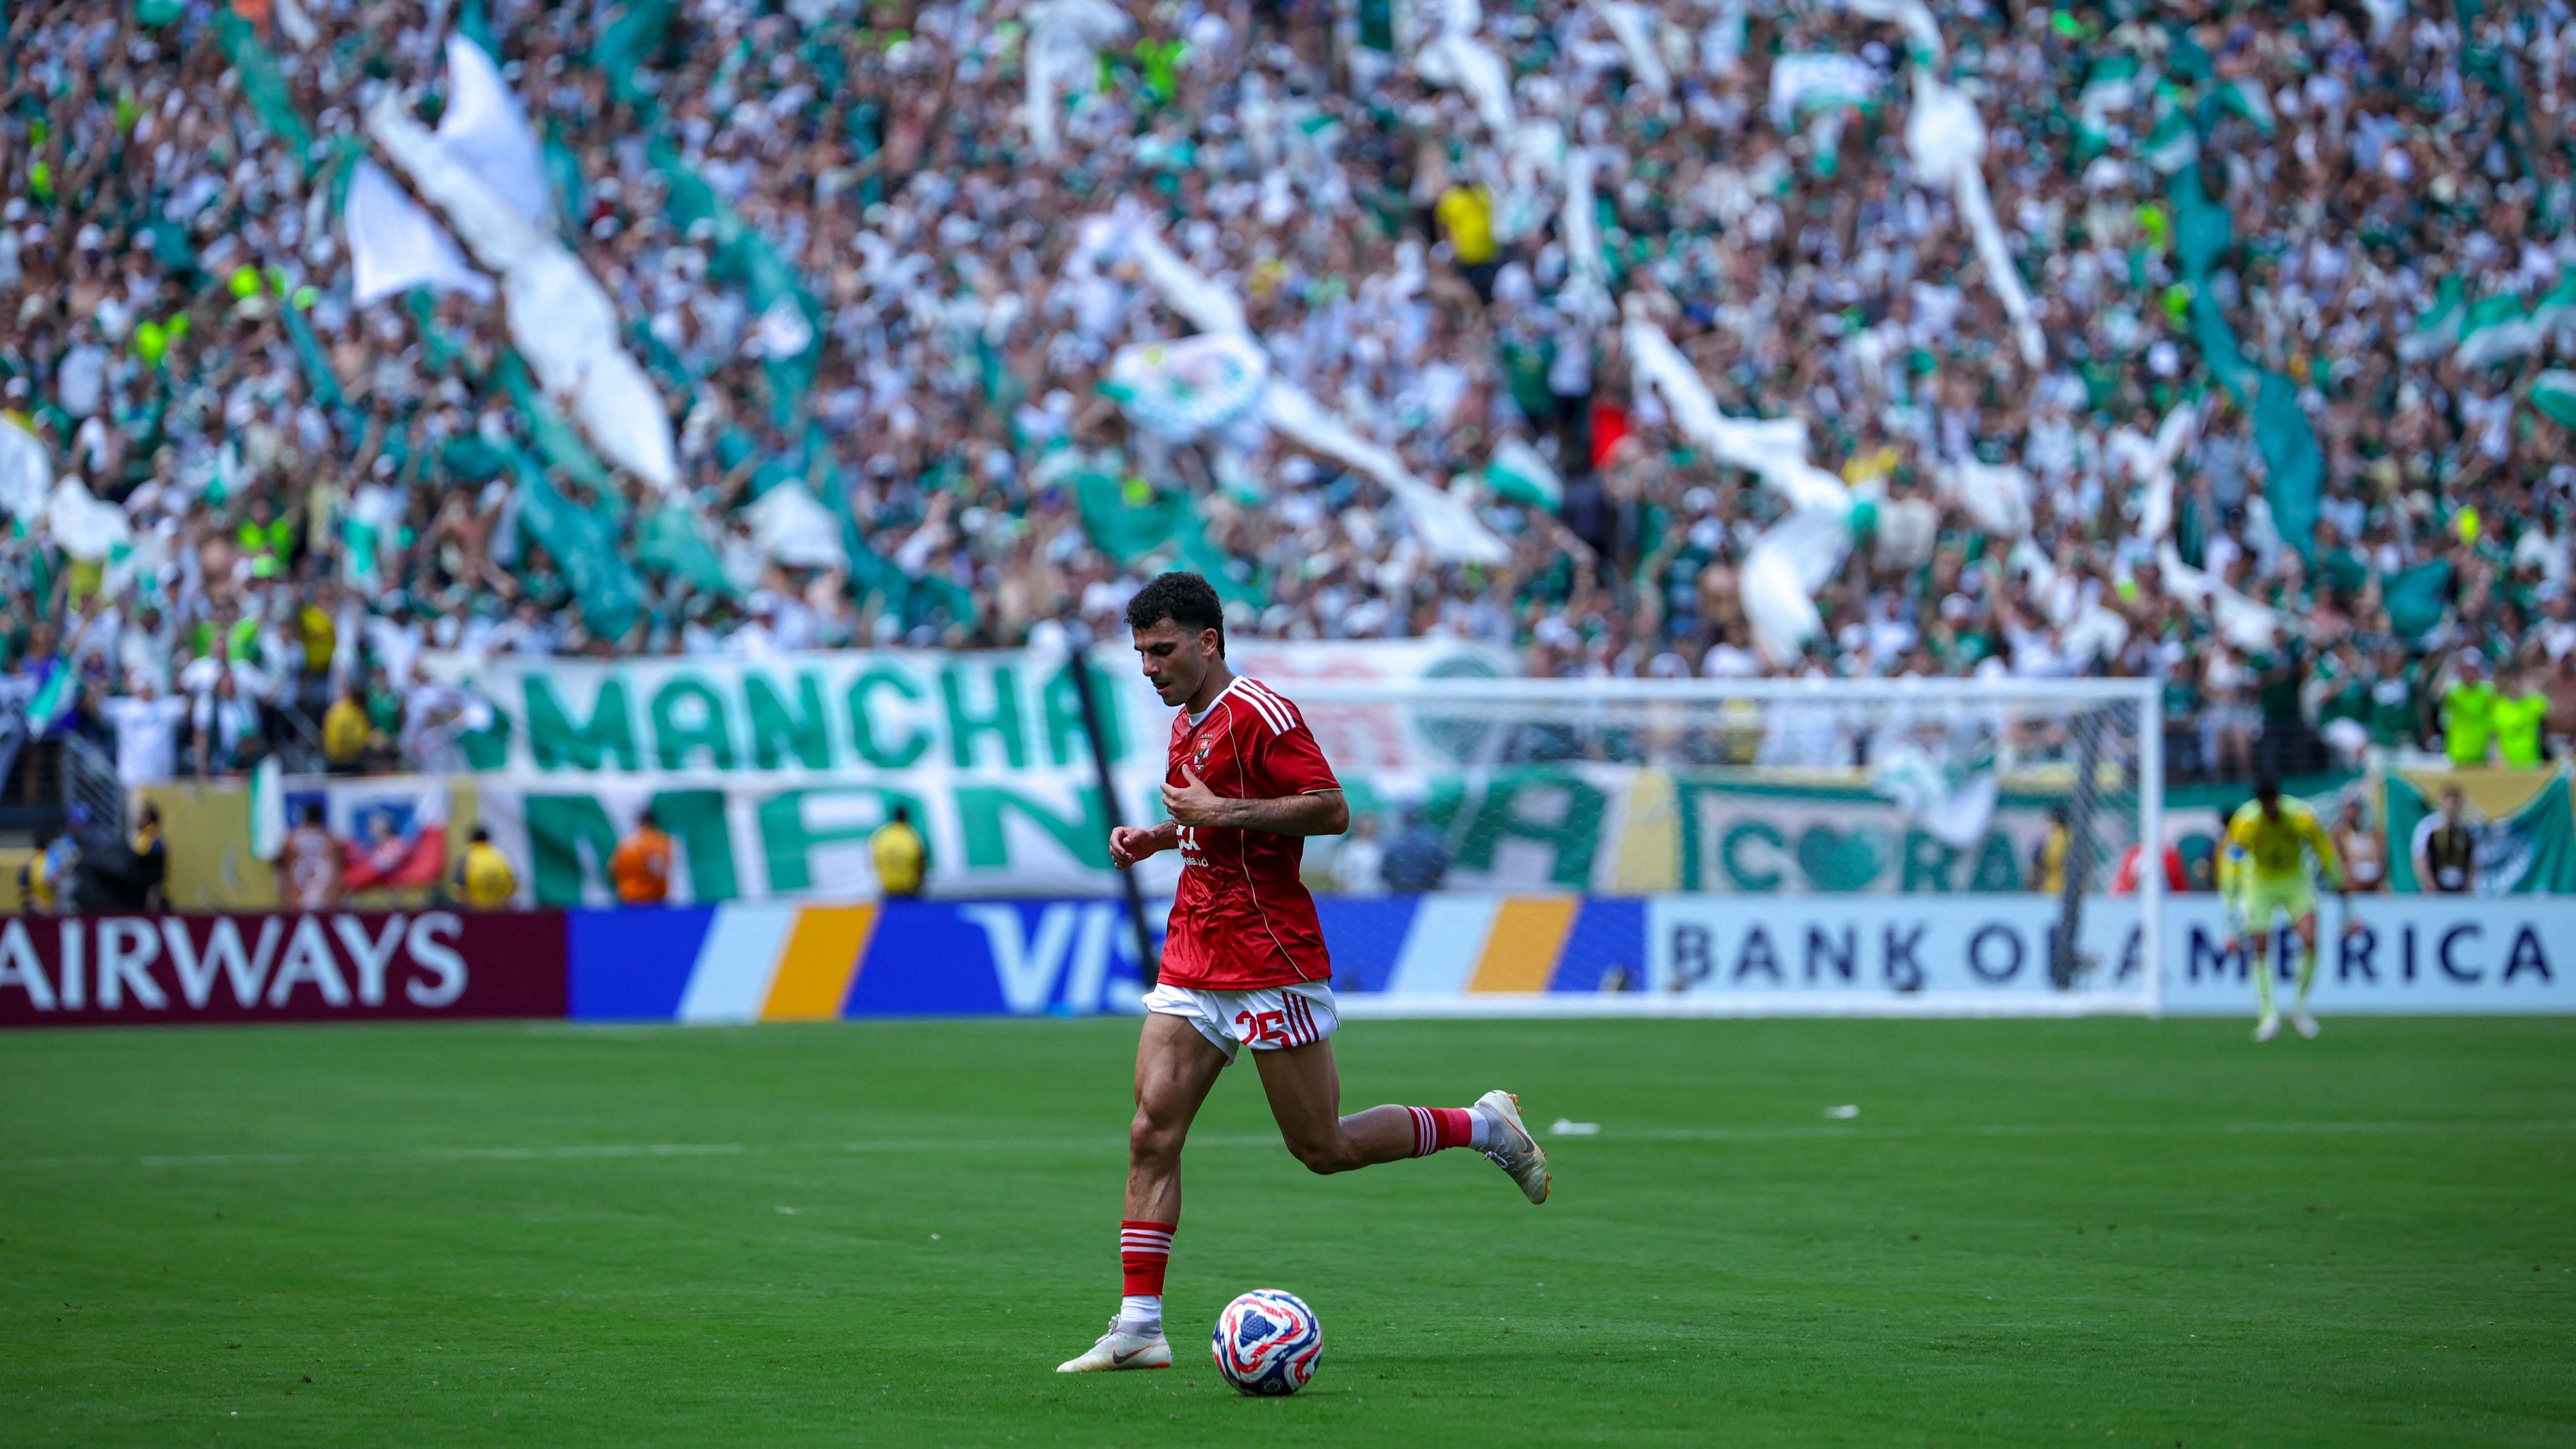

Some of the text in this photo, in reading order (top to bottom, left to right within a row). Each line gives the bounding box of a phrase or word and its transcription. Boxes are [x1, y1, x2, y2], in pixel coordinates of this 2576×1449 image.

[522, 663, 1123, 770] MANCHA
[0, 913, 468, 1010] AIRWAYS
[959, 902, 1165, 1013] VIS
[1670, 924, 1928, 982] BANK
[1235, 1010, 1293, 1049] 25
